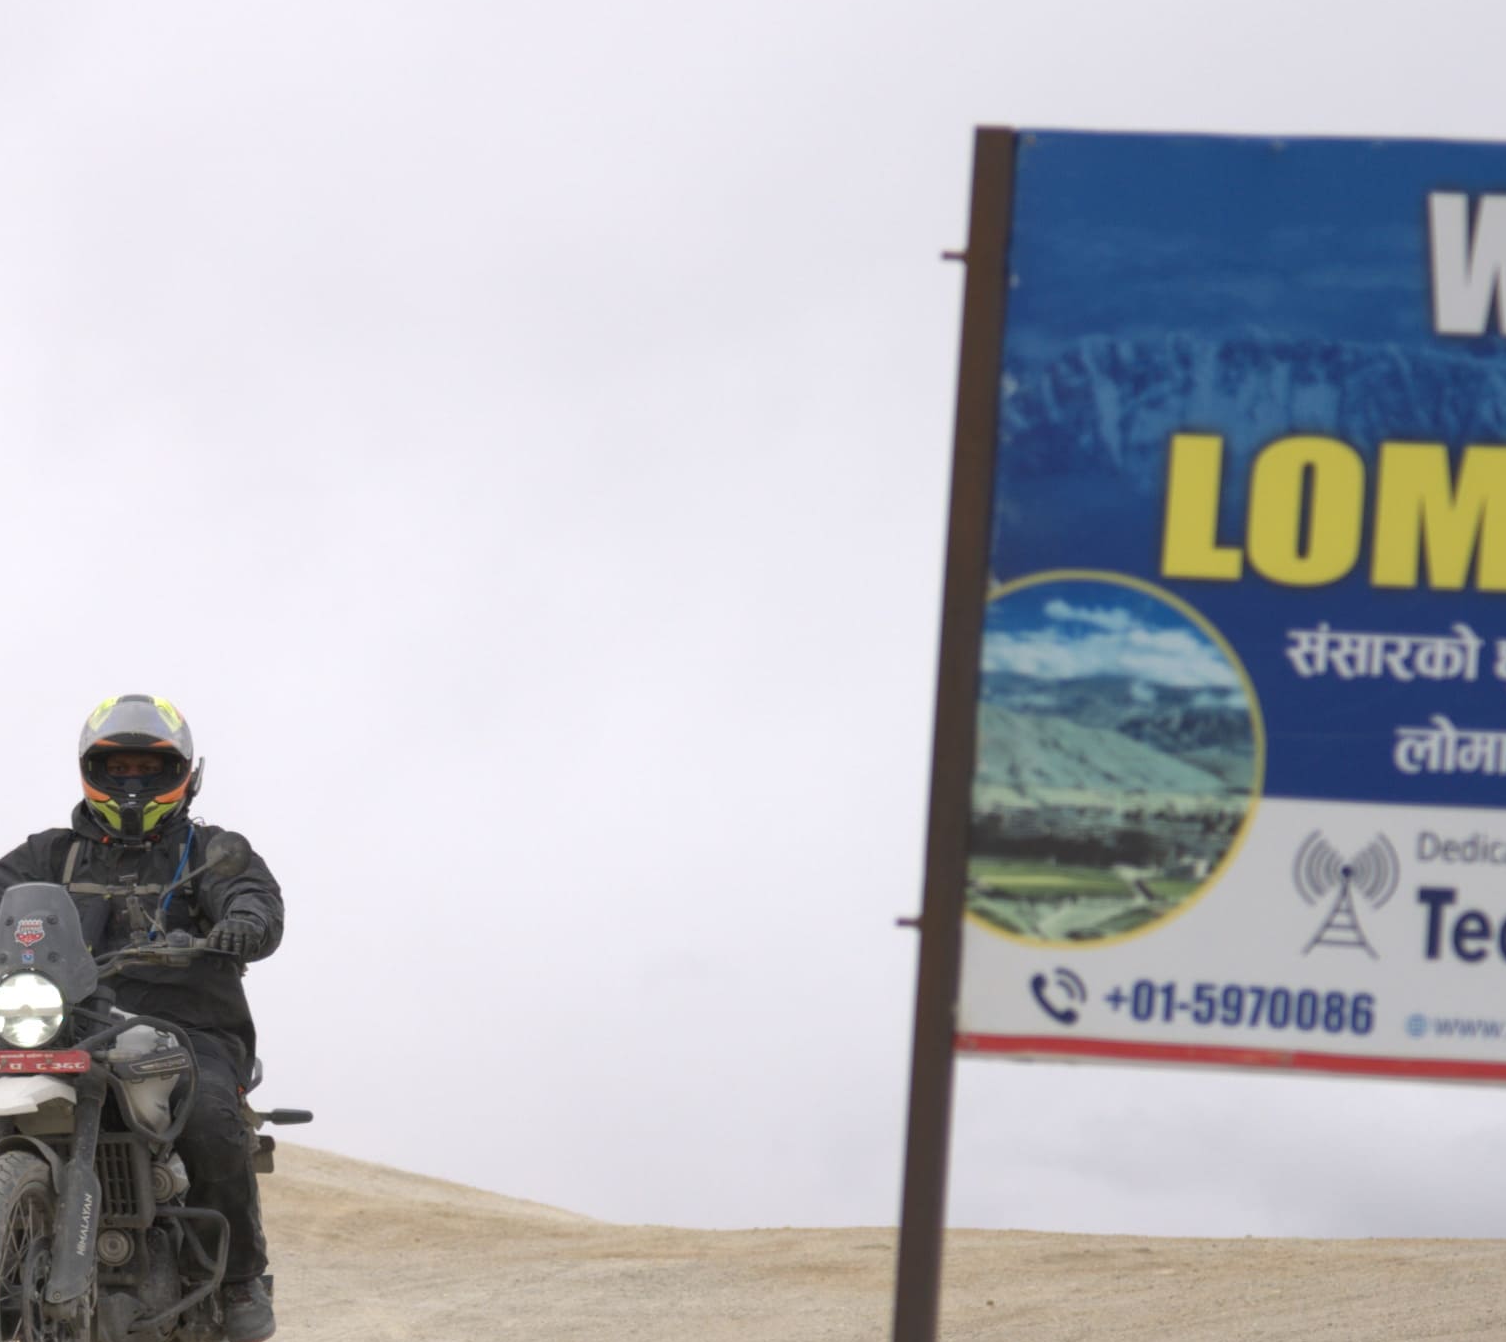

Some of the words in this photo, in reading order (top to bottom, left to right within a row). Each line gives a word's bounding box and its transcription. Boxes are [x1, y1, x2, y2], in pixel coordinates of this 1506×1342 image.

[1287, 622, 1484, 681] संसारको
[1105, 979, 1377, 1037] +01-5970086
[76, 1192, 93, 1256] HIMALAYAN
